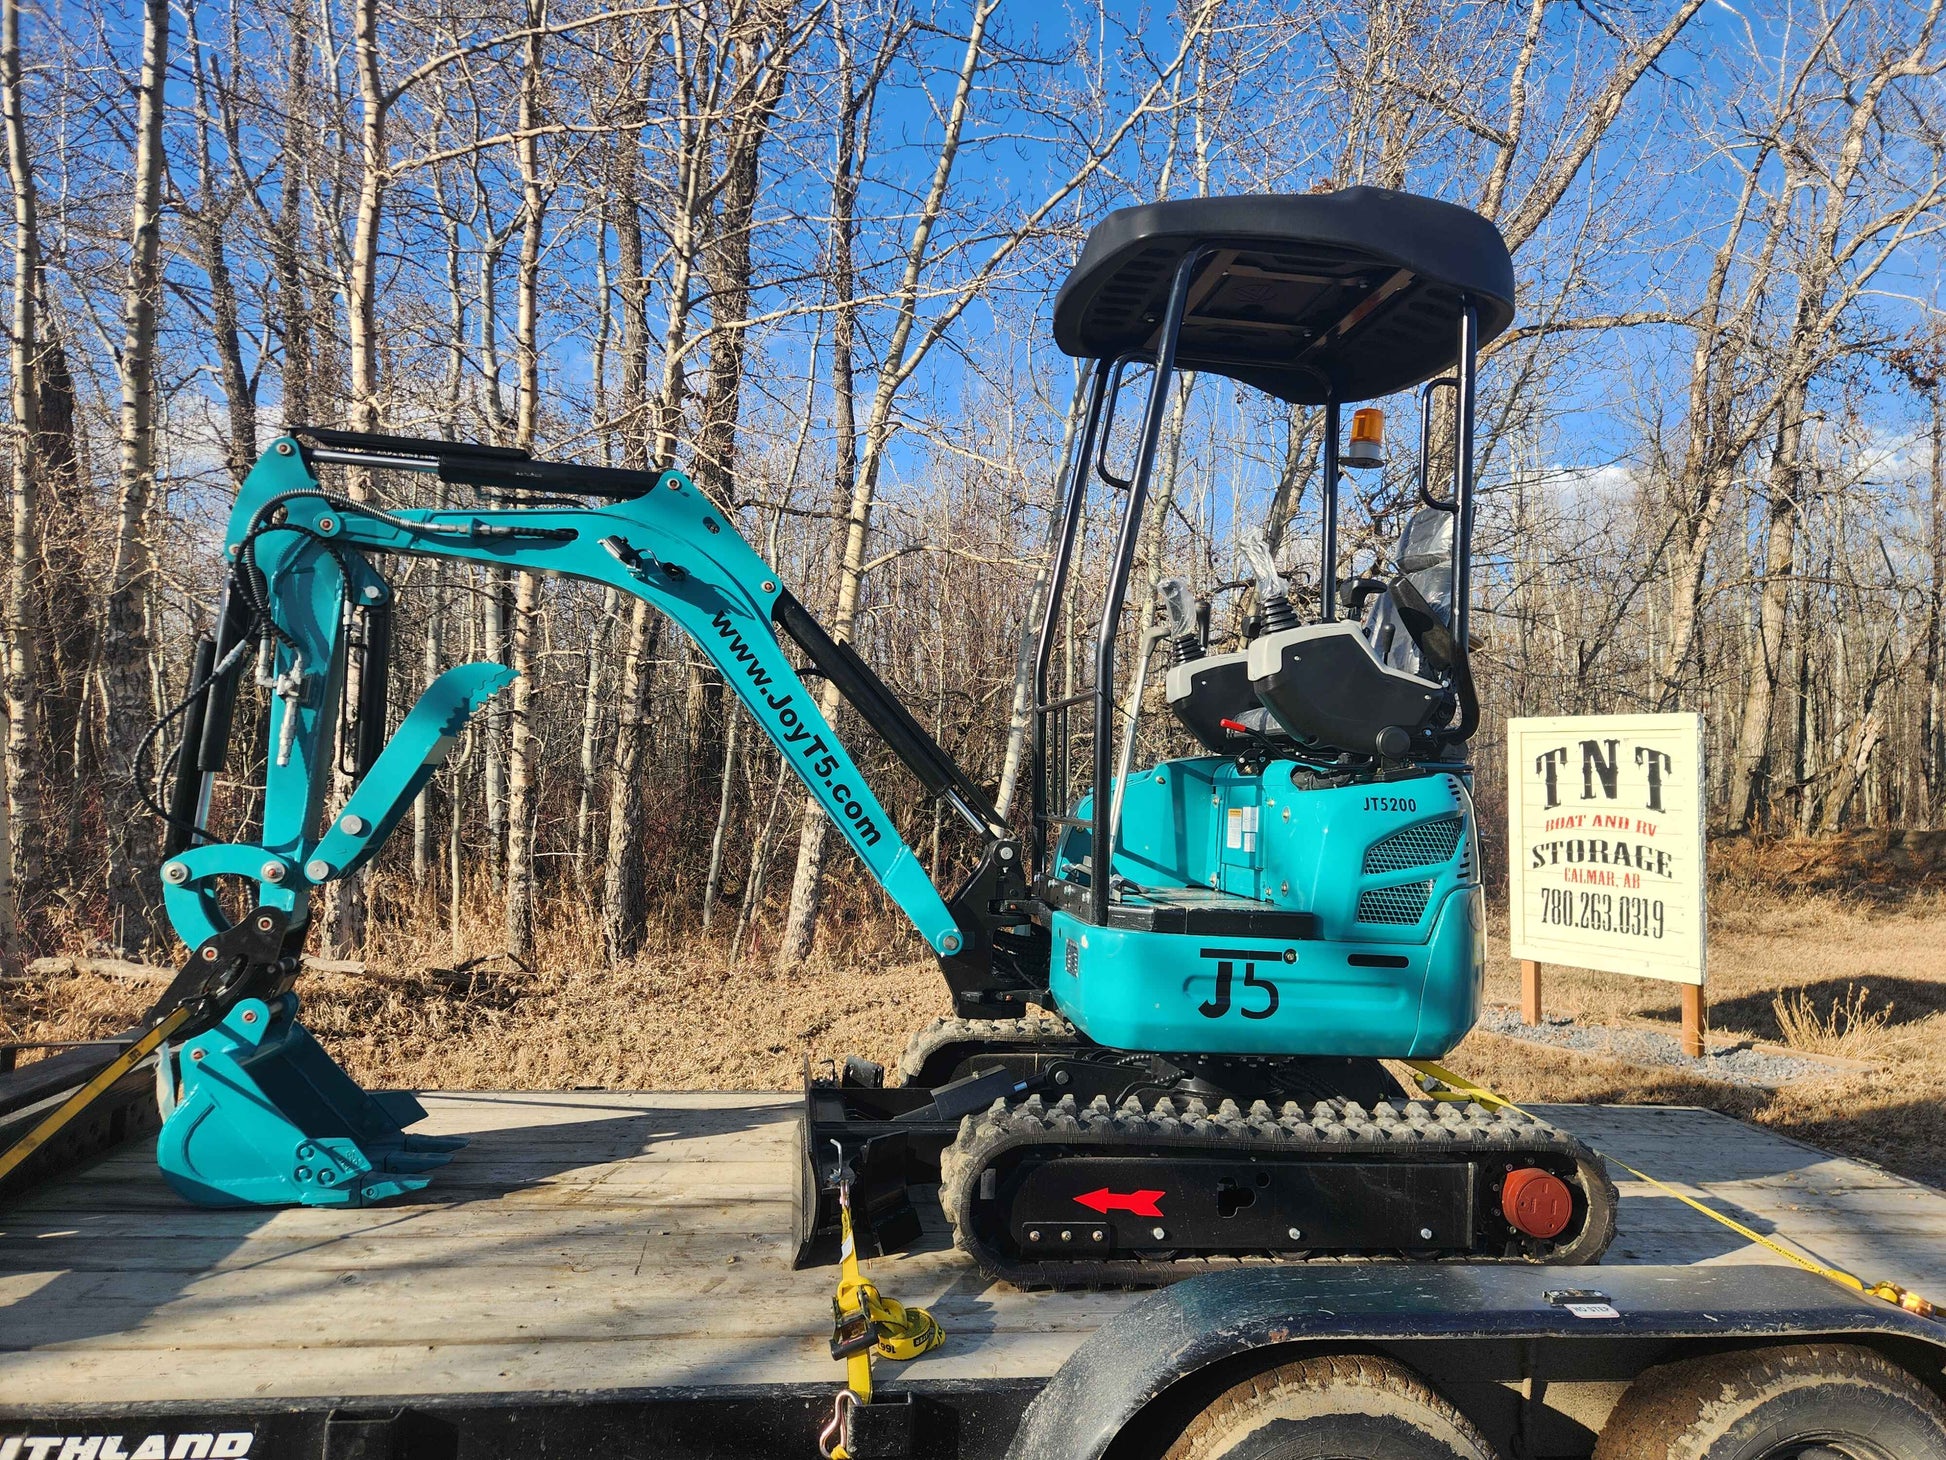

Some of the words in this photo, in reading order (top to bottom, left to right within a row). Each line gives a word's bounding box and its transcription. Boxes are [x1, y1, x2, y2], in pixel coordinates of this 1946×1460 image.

[711, 610, 882, 847] www.JoyT5.com
[1535, 738, 1672, 814] TNT
[1363, 797, 1417, 813] JT5200
[1545, 814, 1587, 832] BOAT
[1592, 814, 1630, 830] AND
[1636, 819, 1657, 837] RV
[1532, 838, 1672, 879] STORAGE
[1564, 867, 1619, 888] CALMAR,
[1623, 872, 1641, 889] AB
[1541, 887, 1664, 939] 780.263.0319
